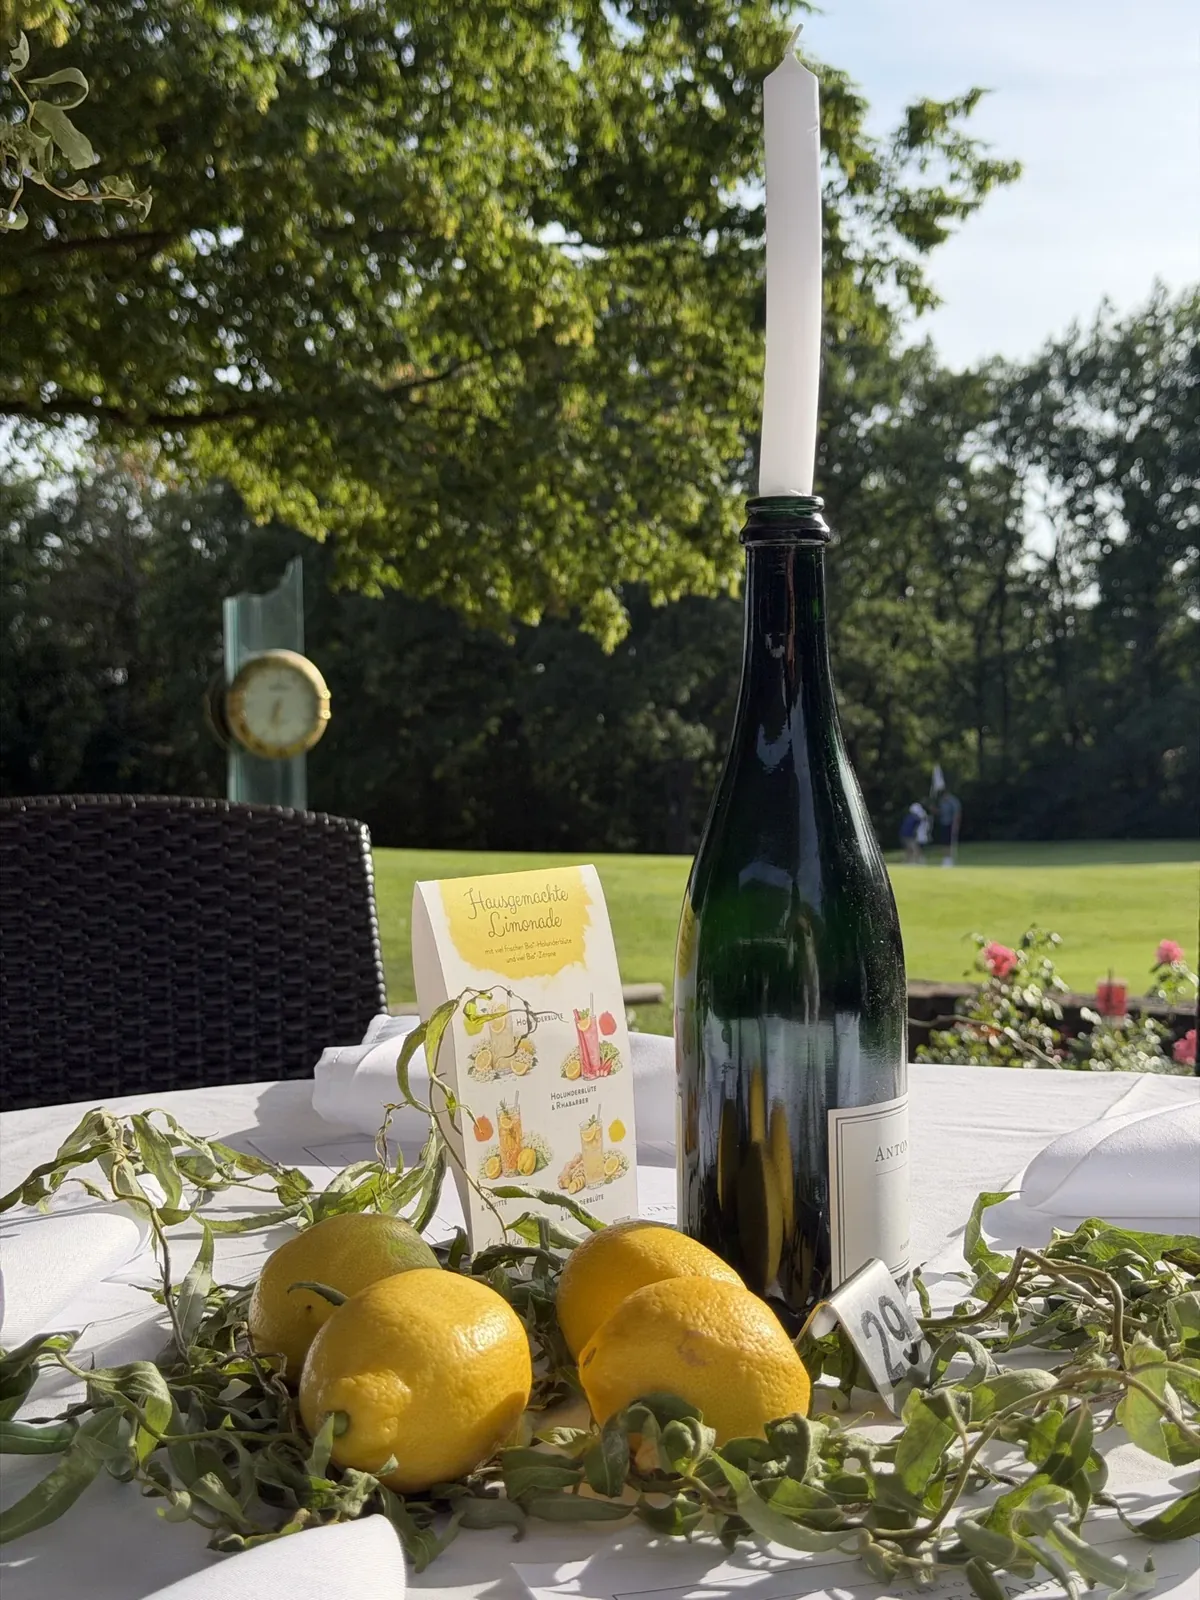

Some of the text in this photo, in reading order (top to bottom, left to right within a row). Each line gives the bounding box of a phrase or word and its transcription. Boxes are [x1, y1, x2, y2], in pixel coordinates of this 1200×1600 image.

[463, 884, 569, 920] Hausgemachte
[488, 907, 563, 938] Limonade
[556, 1097, 589, 1110] RHABARBER
[859, 1295, 920, 1388] 29
